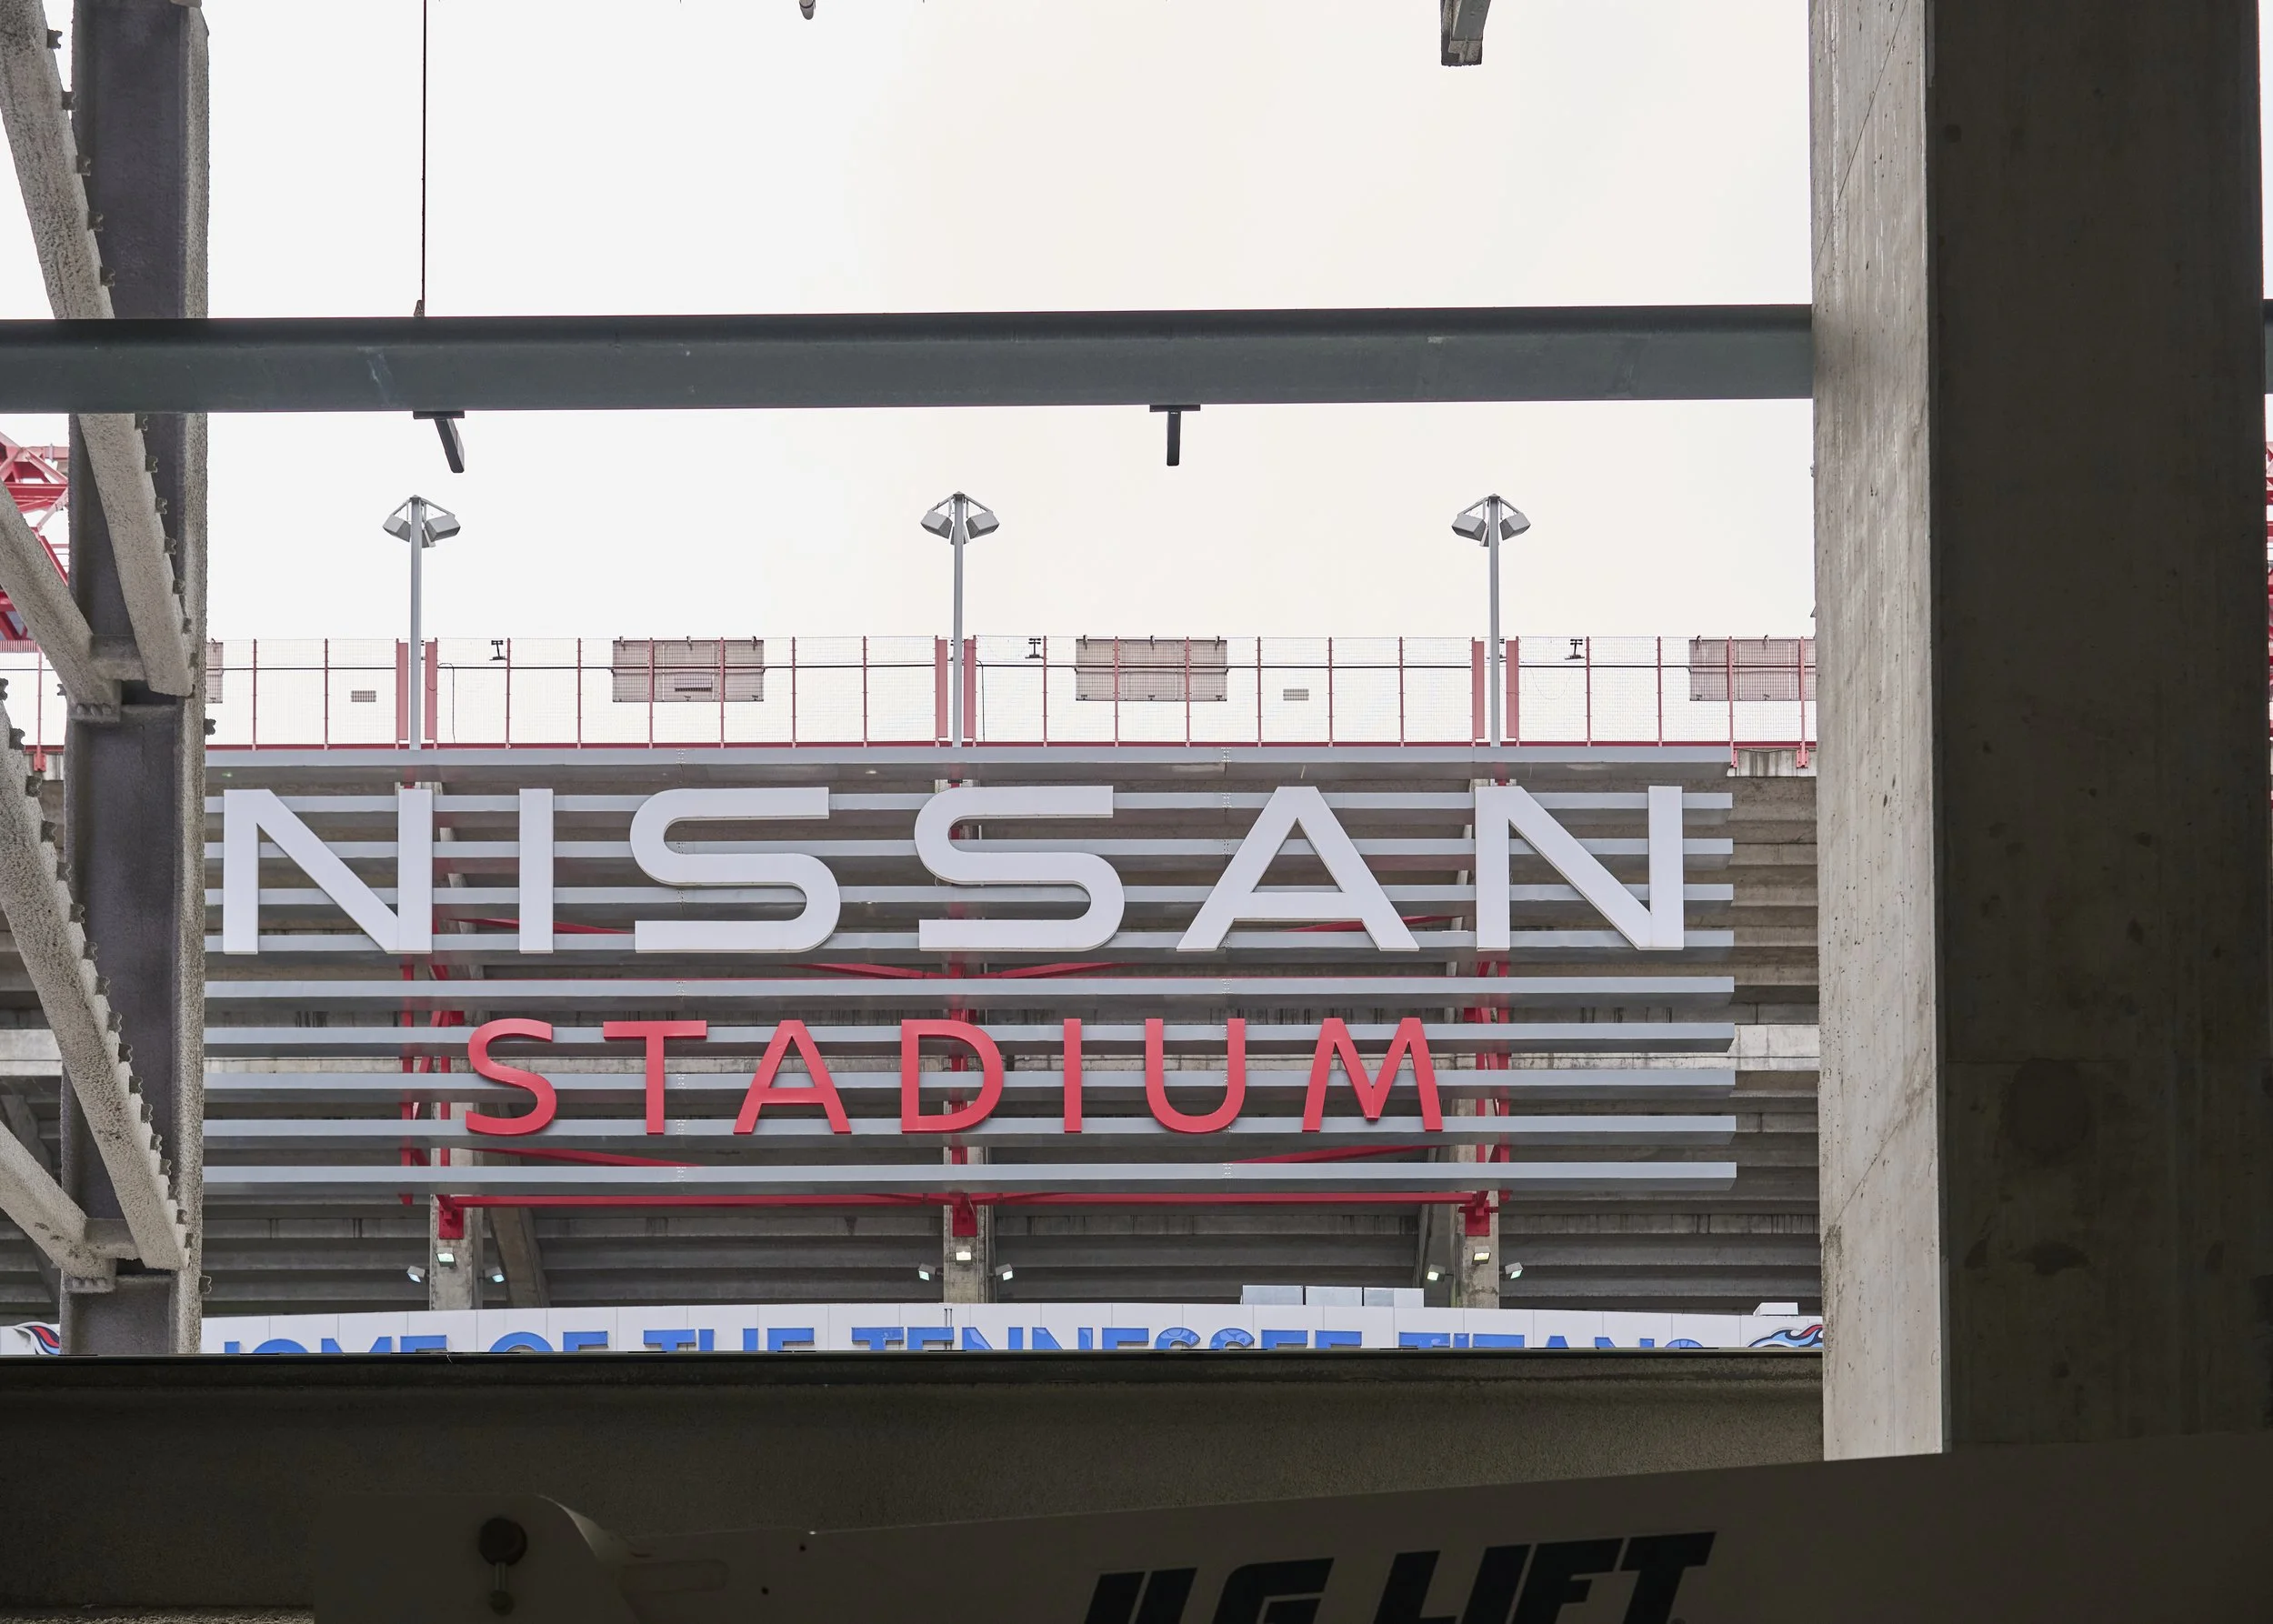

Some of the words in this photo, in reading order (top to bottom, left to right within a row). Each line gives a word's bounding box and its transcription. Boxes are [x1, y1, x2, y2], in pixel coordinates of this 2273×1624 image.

[223, 786, 1685, 954] NISSAN
[465, 1018, 1444, 1136] STADIUM
[1373, 1531, 1717, 1624] LIFT
